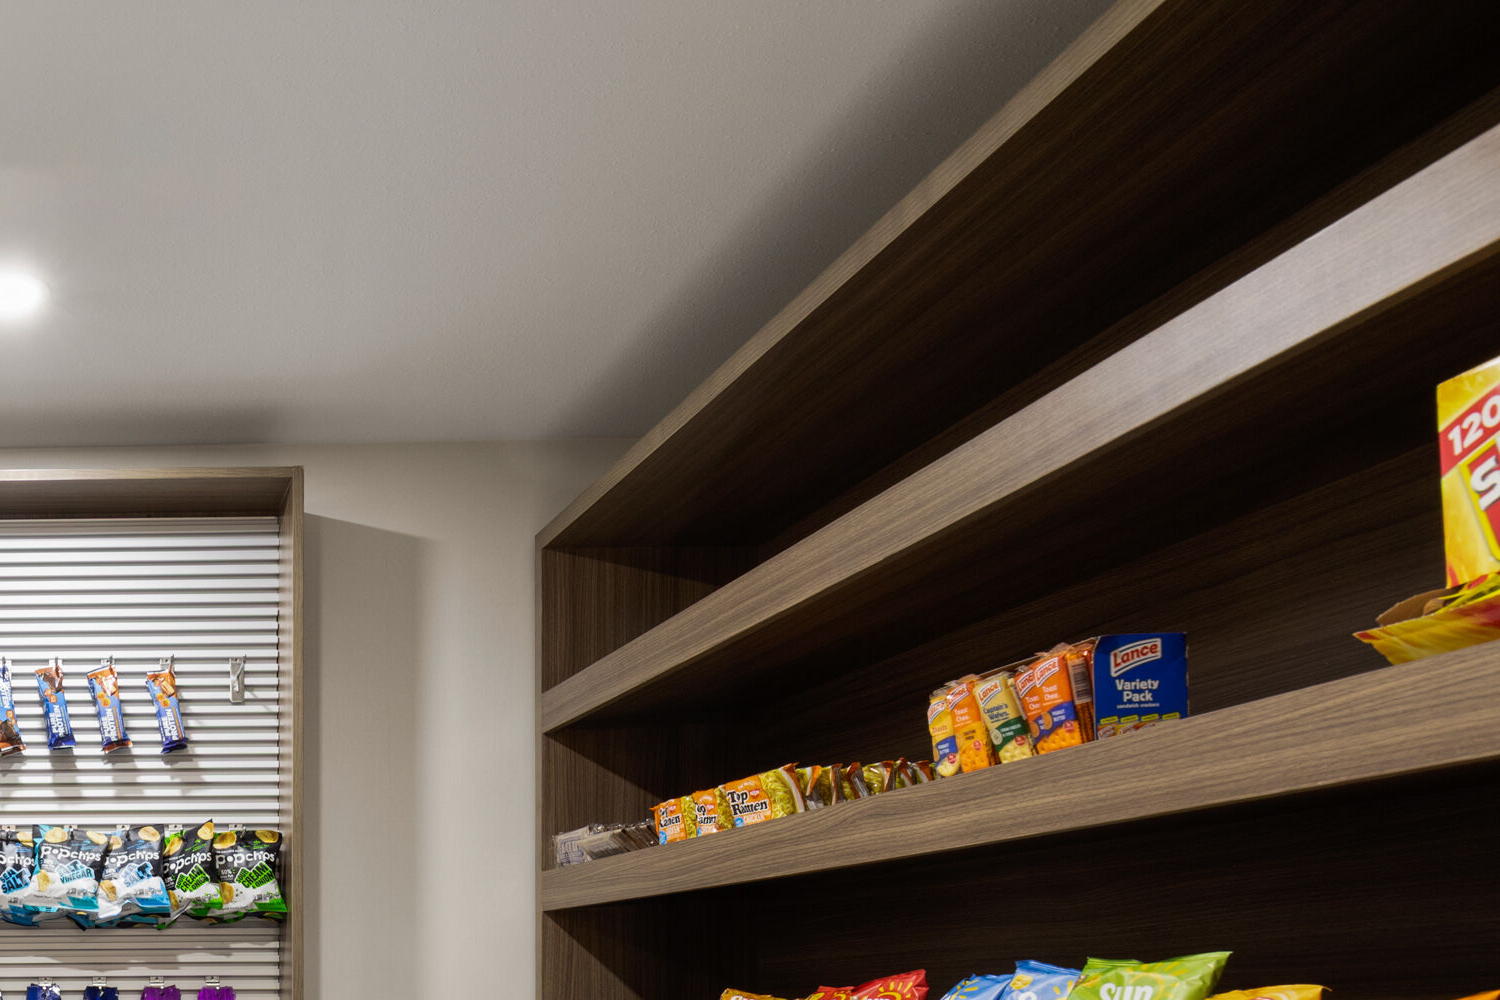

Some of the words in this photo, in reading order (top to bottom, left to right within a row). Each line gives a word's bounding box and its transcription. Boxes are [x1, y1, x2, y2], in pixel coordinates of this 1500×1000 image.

[1113, 642, 1159, 669] Lance
[979, 681, 999, 701] Lance
[1115, 679, 1159, 692] Variety
[1123, 691, 1153, 702] Pack
[49, 712, 58, 734] PURE
[52, 704, 65, 738] PROTEIN
[101, 715, 112, 738] PURE
[104, 708, 119, 741] PROTEIN
[161, 716, 172, 737] PURE
[165, 708, 180, 741] PROTEIN
[727, 790, 749, 804] Top
[731, 800, 769, 816] Ramen
[40, 844, 102, 863] popchips
[216, 851, 277, 868] popchips
[0, 868, 18, 884] SEA
[2, 870, 31, 894] SALT
[60, 867, 93, 885] VINEGAR
[181, 866, 204, 893] CREAM
[193, 874, 211, 891] ONION
[236, 867, 250, 884] SOUR
[242, 863, 270, 888] CREAM
[256, 873, 276, 889] ONION
